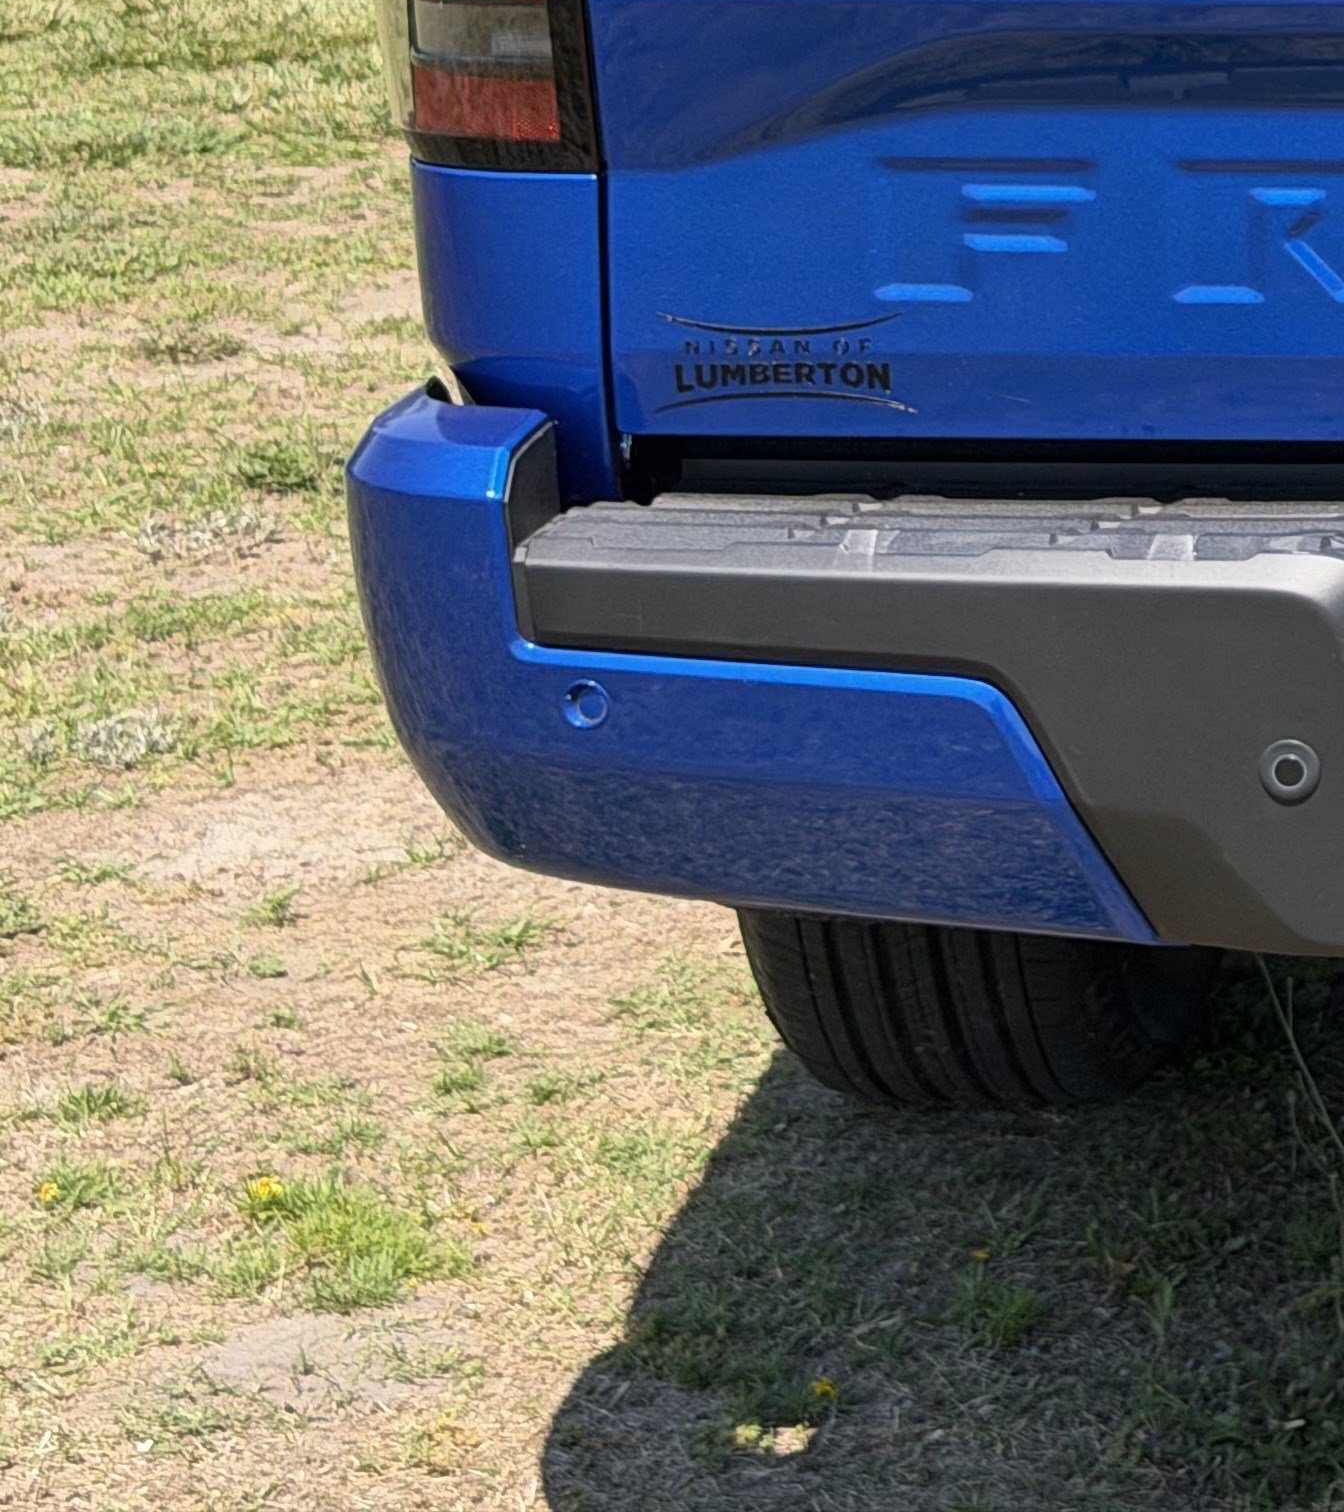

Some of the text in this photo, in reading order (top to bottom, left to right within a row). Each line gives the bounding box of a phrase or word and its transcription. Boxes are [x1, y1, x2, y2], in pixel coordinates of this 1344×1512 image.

[685, 338, 872, 356] NISSAN OF
[674, 361, 892, 392] LUMBERTON
